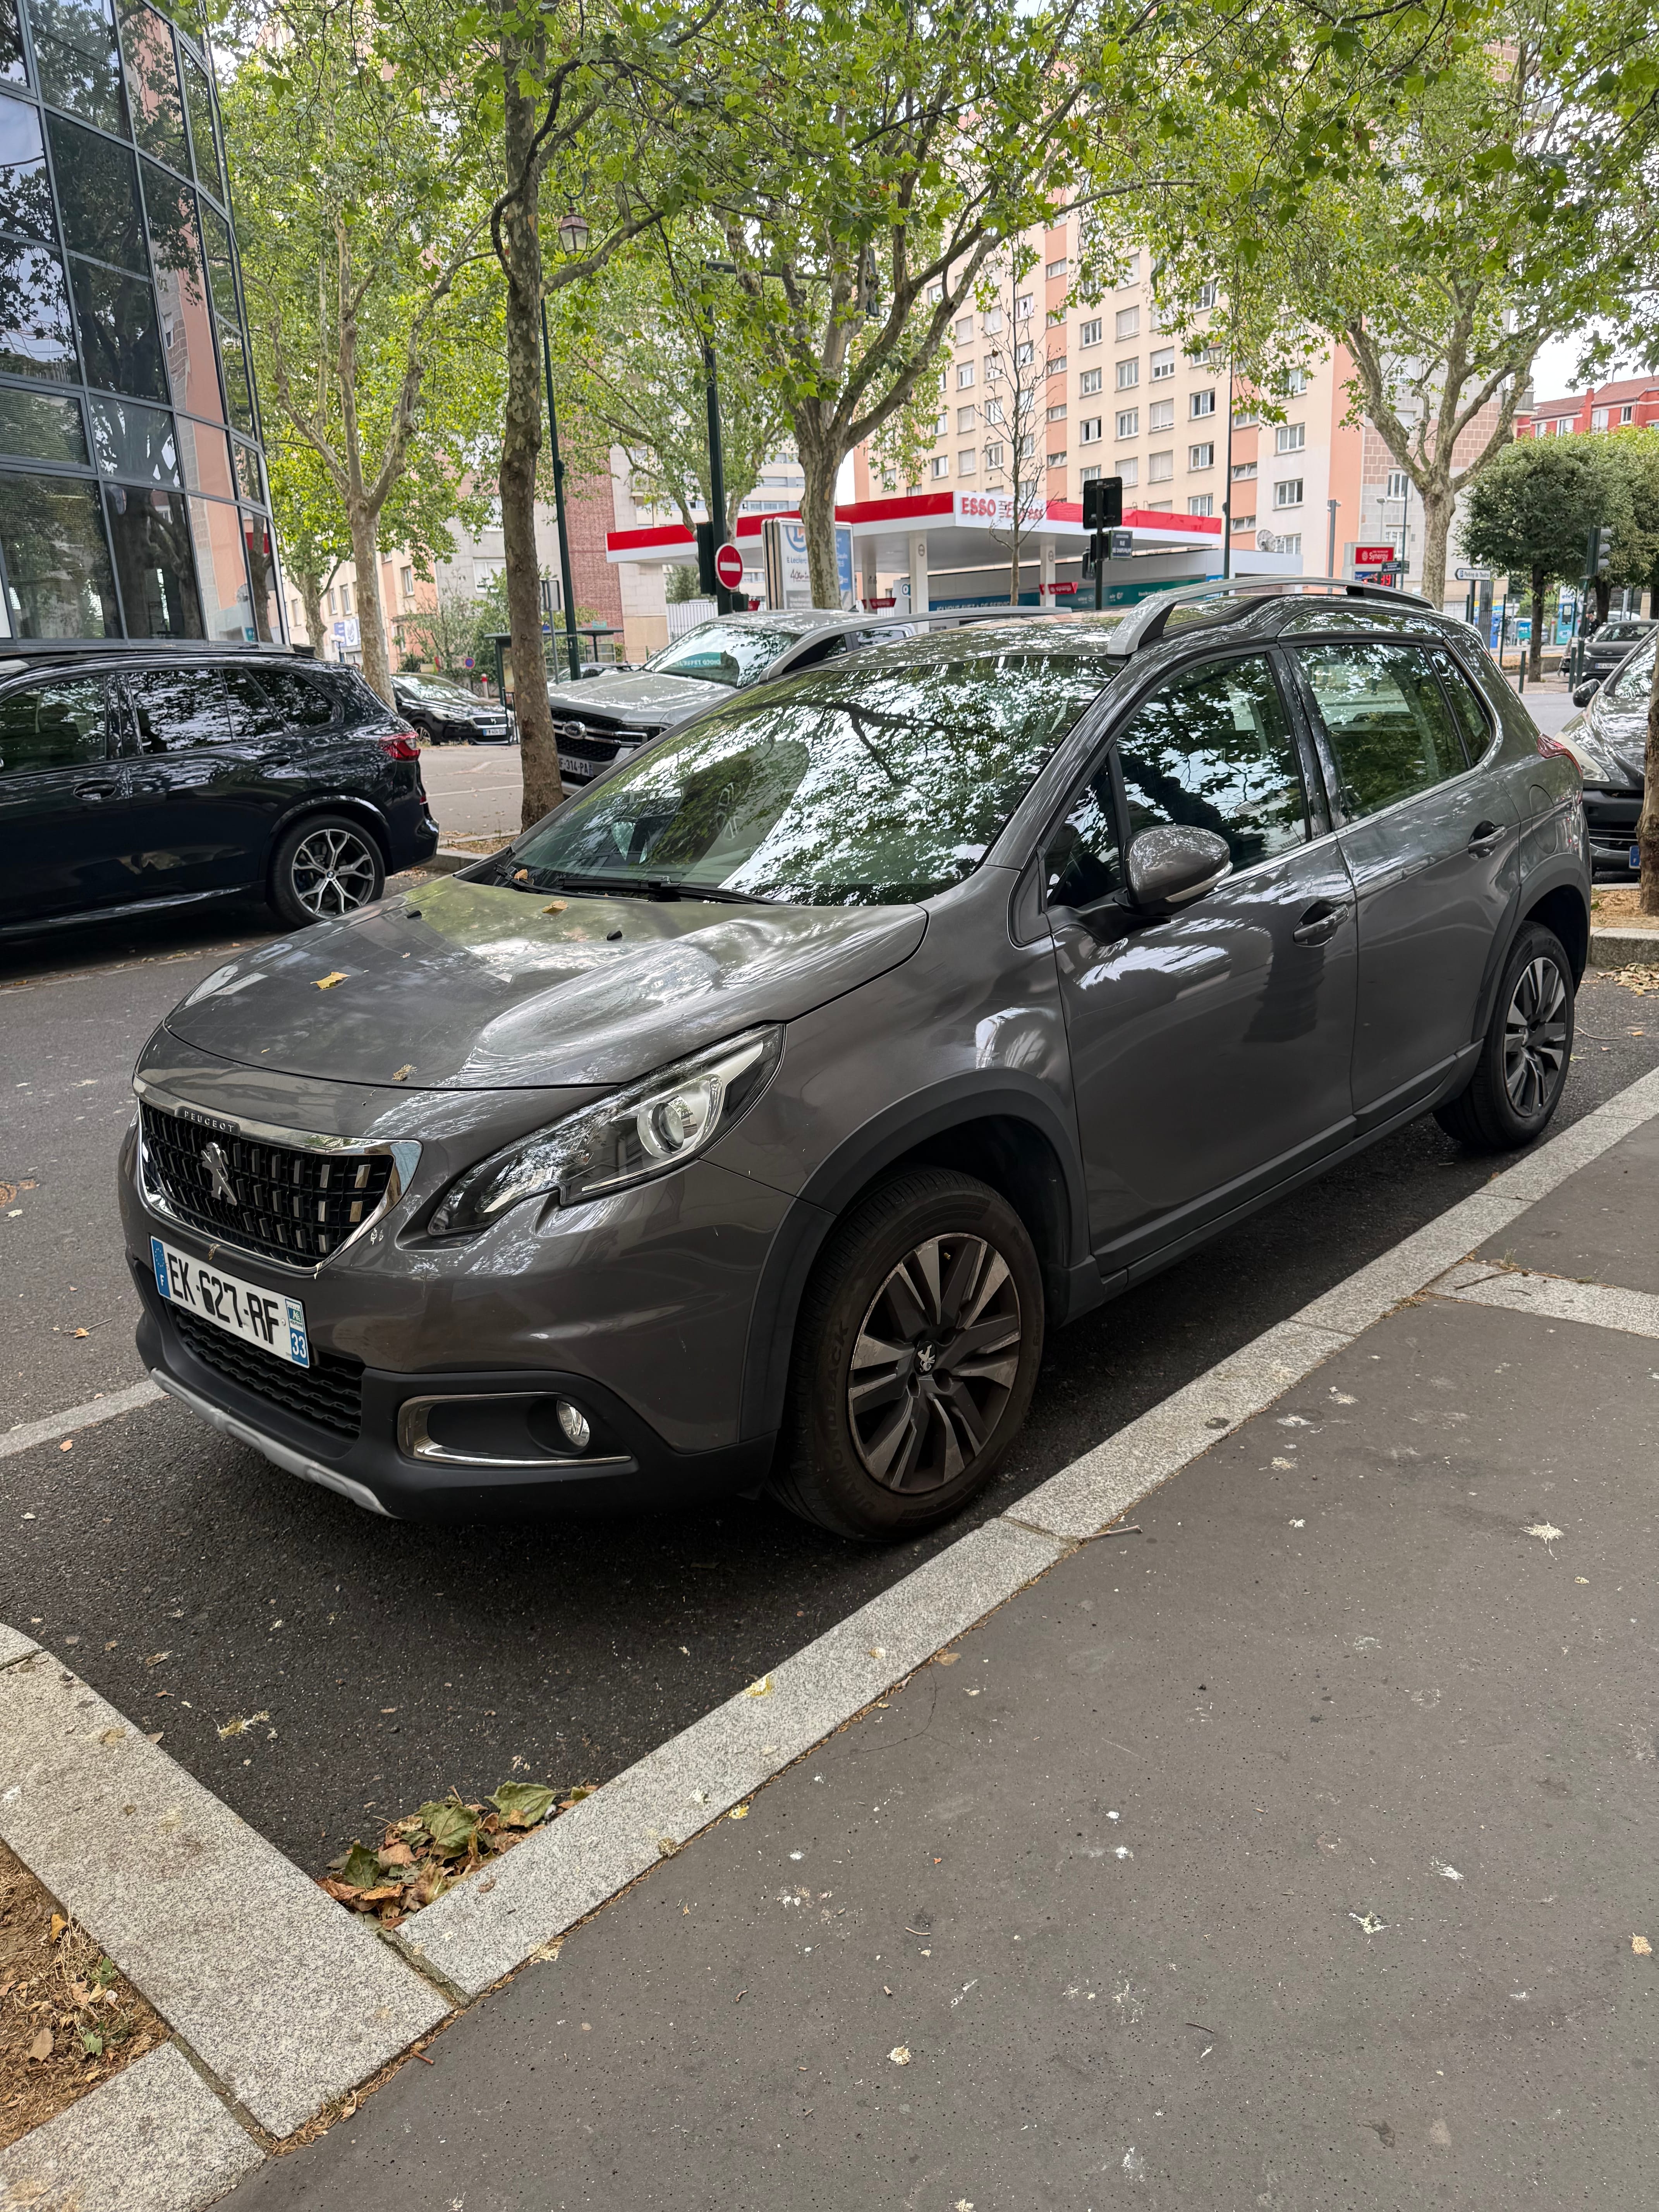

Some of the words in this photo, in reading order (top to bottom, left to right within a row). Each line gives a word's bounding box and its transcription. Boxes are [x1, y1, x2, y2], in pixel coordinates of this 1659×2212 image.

[962, 497, 996, 516] ESSO
[1369, 551, 1388, 562] Synergy
[184, 1110, 234, 1132] PEUGEOT
[160, 1274, 164, 1286] F
[167, 1252, 280, 1345] EK-627-RF
[291, 1333, 307, 1358] 33
